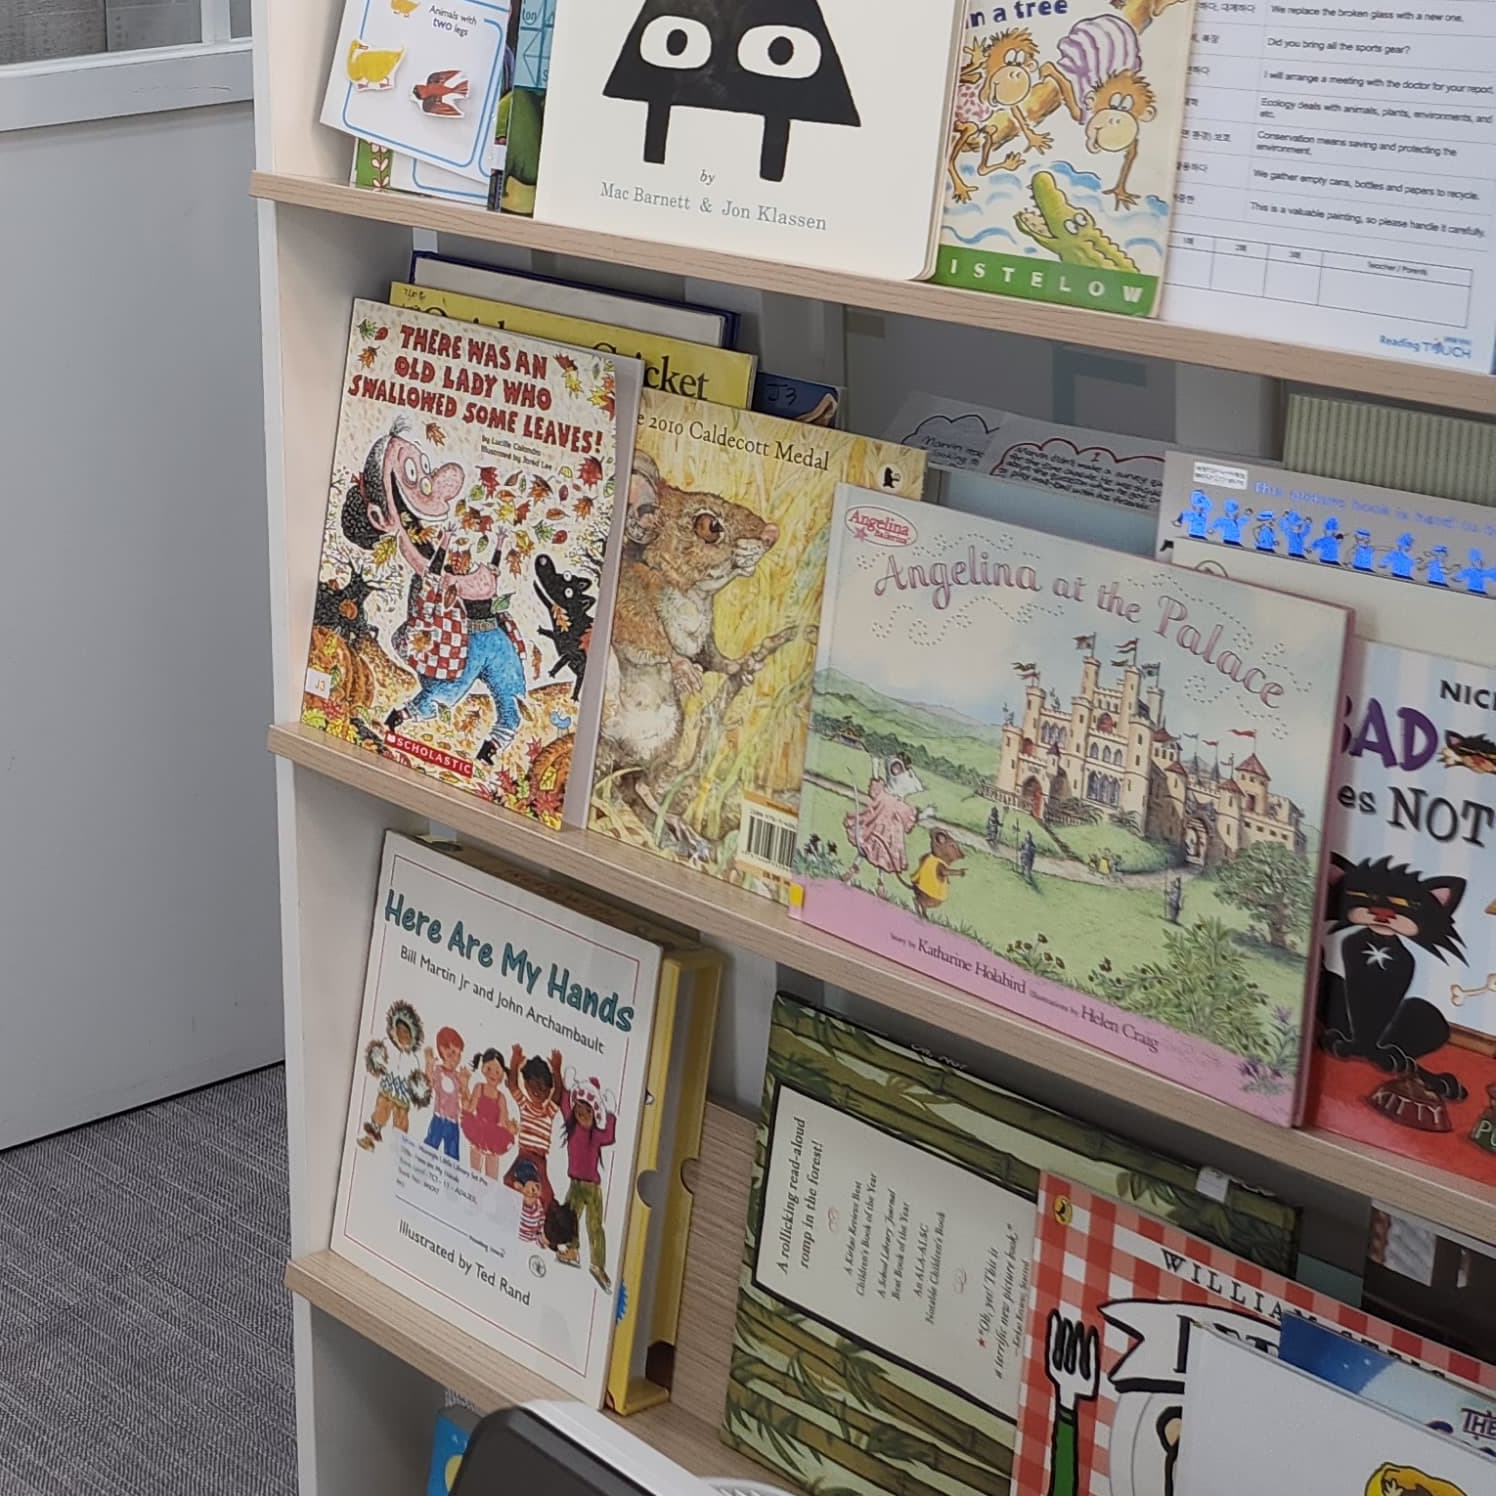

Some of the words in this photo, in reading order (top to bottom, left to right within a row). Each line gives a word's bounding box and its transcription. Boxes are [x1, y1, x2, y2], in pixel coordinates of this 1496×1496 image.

[429, 5, 459, 21] Animals
[460, 15, 477, 26] with
[433, 17, 452, 32] two
[454, 25, 468, 38] legs
[993, 7, 1007, 23] a
[1014, 0, 1068, 20] tree
[699, 169, 715, 186] by
[600, 181, 630, 202] Mac
[633, 187, 691, 212] Barnett
[699, 197, 714, 213] &
[721, 200, 751, 220] Jon
[757, 205, 828, 232] Klassen
[399, 324, 464, 360] THERE
[467, 339, 510, 372] WAS
[514, 350, 549, 380] AN
[393, 355, 436, 385] OLD
[442, 365, 498, 399] LADY
[502, 378, 553, 411] WHO
[347, 374, 458, 419] SWALLOWED
[462, 400, 519, 434] SOME
[522, 414, 605, 455] LEAVES!
[649, 415, 685, 436] 2010
[689, 420, 770, 457] Caldecott
[774, 440, 830, 472] Medal
[849, 509, 910, 538] Angelina
[874, 545, 1041, 611] Angelina
[1052, 576, 1085, 603] at
[1095, 581, 1143, 624] the
[1153, 594, 1287, 709] Palace
[396, 737, 474, 775] SCHOLASTIC
[1387, 785, 1496, 849] NOT
[384, 889, 443, 945] Here
[447, 920, 494, 968] Are
[502, 942, 543, 994] My
[547, 962, 635, 1033] Hands
[918, 938, 973, 973] Katharine
[975, 961, 1028, 996] Holabird
[400, 945, 417, 966] Bill
[419, 954, 457, 986] Martin
[459, 971, 472, 992] Jr
[473, 980, 495, 1002] and
[496, 991, 524, 1016] John
[525, 1005, 605, 1055] Archambault
[1081, 1004, 1121, 1037] Helen
[1121, 1021, 1160, 1053] Craig
[1372, 1090, 1444, 1128] KITTY
[788, 1116, 806, 1190] read-aloud
[806, 1140, 823, 1187] forest!
[780, 1190, 800, 1259] rollicking
[803, 1213, 815, 1231] in
[805, 1190, 817, 1213] the
[398, 1218, 454, 1262] Illustrated
[457, 1252, 473, 1274] by
[474, 1262, 496, 1287] Ted
[499, 1277, 531, 1307] Rand
[776, 1261, 789, 1275] A
[799, 1231, 816, 1270] romp
